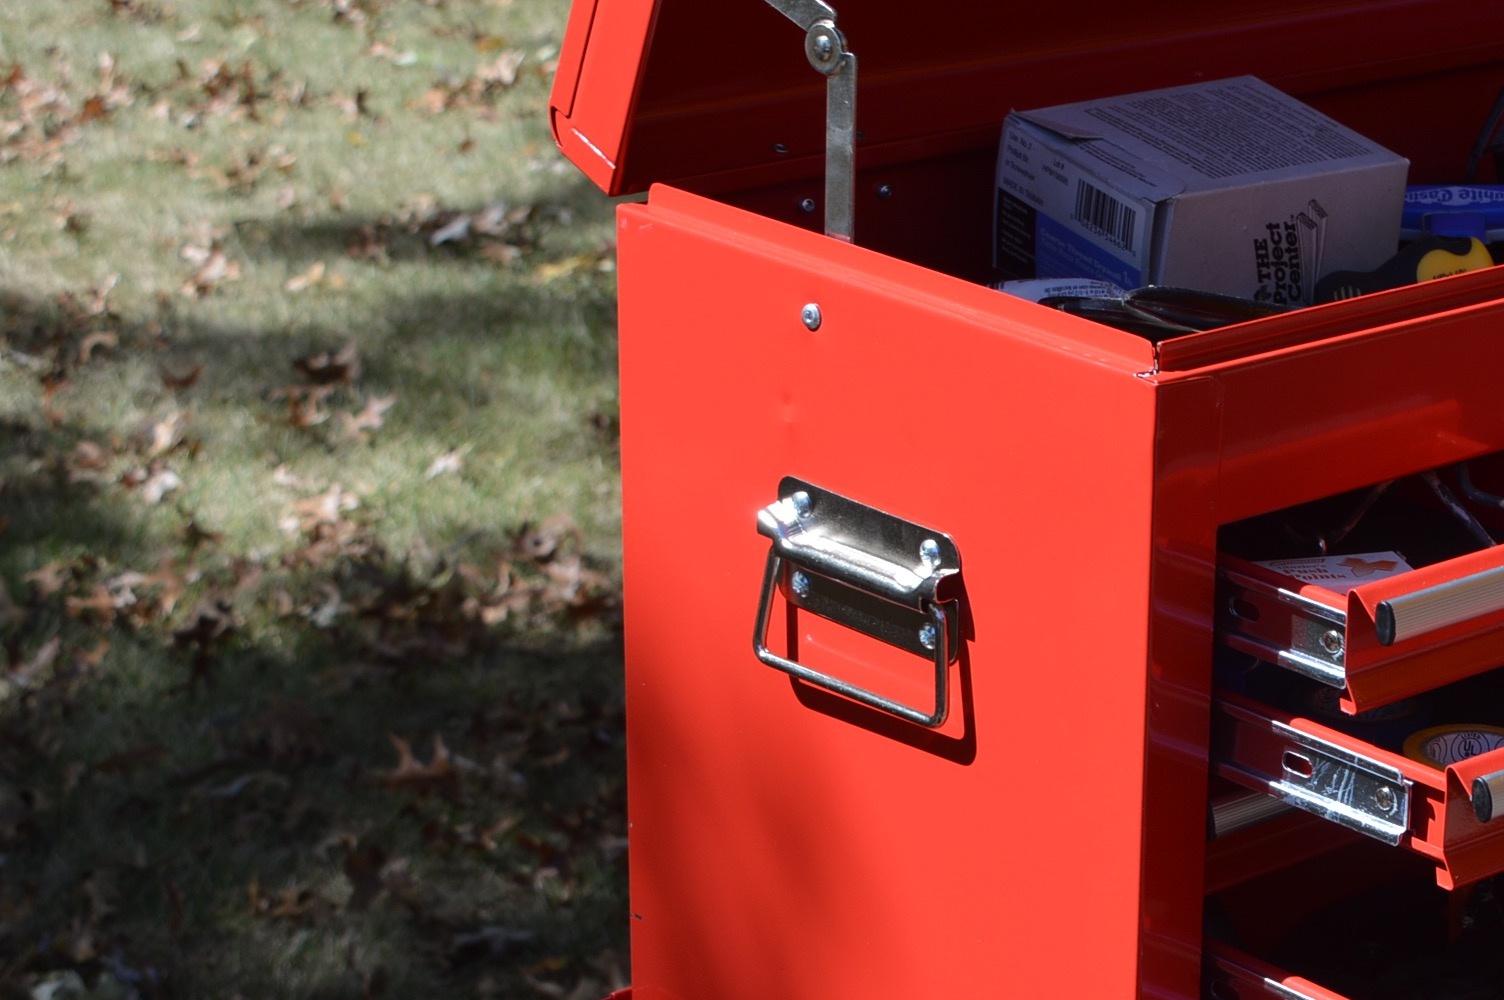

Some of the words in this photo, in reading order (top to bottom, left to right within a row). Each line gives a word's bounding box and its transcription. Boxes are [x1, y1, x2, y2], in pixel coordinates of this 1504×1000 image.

[1254, 238, 1271, 283] THE
[1265, 222, 1288, 305] Project
[1283, 222, 1302, 302] Center
[1282, 567, 1329, 575] Push
[1461, 732, 1482, 740] LISTED
[1463, 740, 1478, 756] UL
